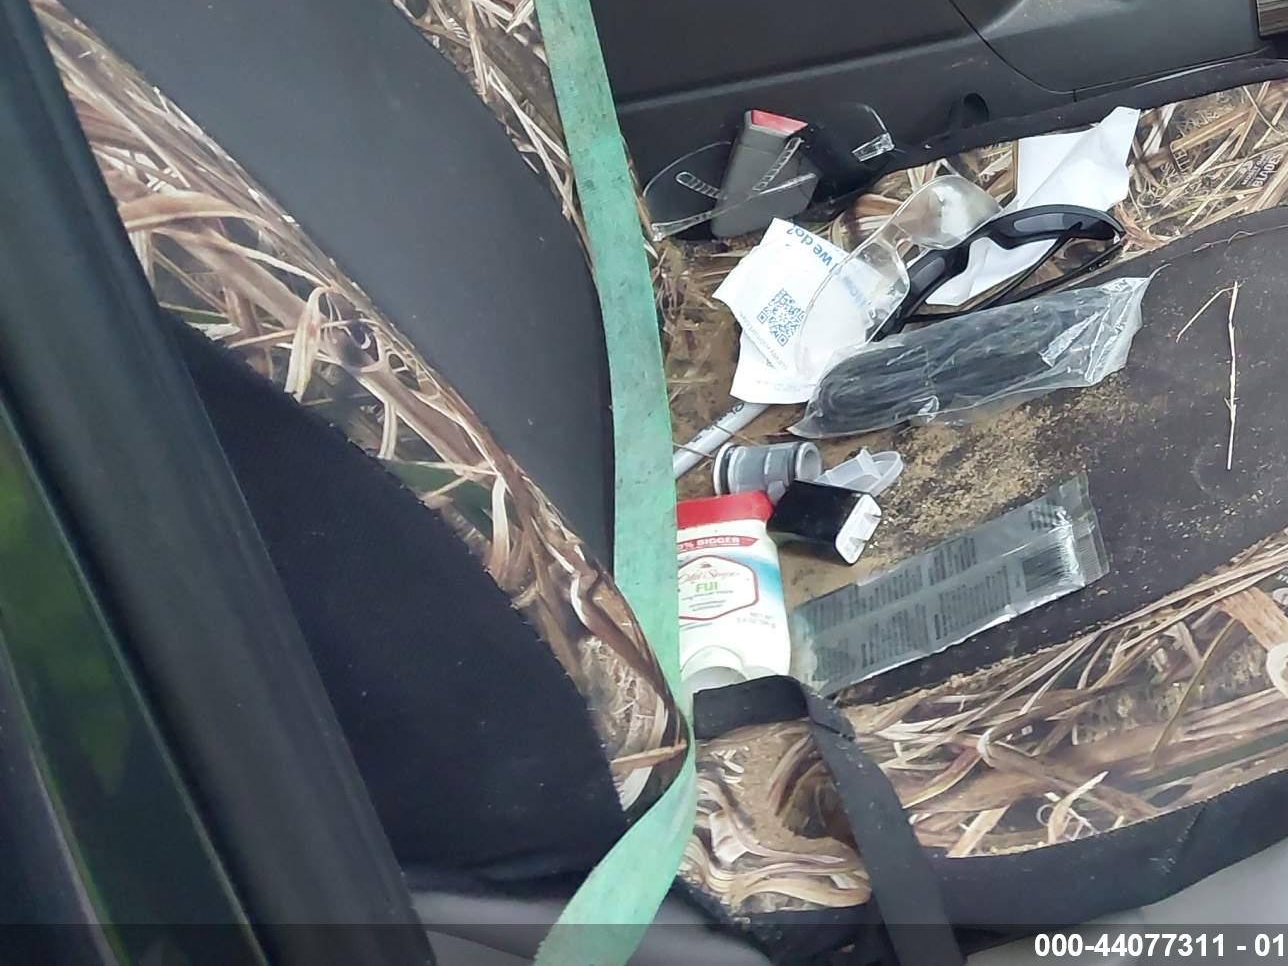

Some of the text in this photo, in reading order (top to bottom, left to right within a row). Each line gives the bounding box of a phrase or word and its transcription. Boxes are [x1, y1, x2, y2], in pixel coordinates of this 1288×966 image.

[1252, 152, 1284, 187] BLADES
[785, 223, 833, 267] we do?
[696, 536, 740, 547] BIGGER
